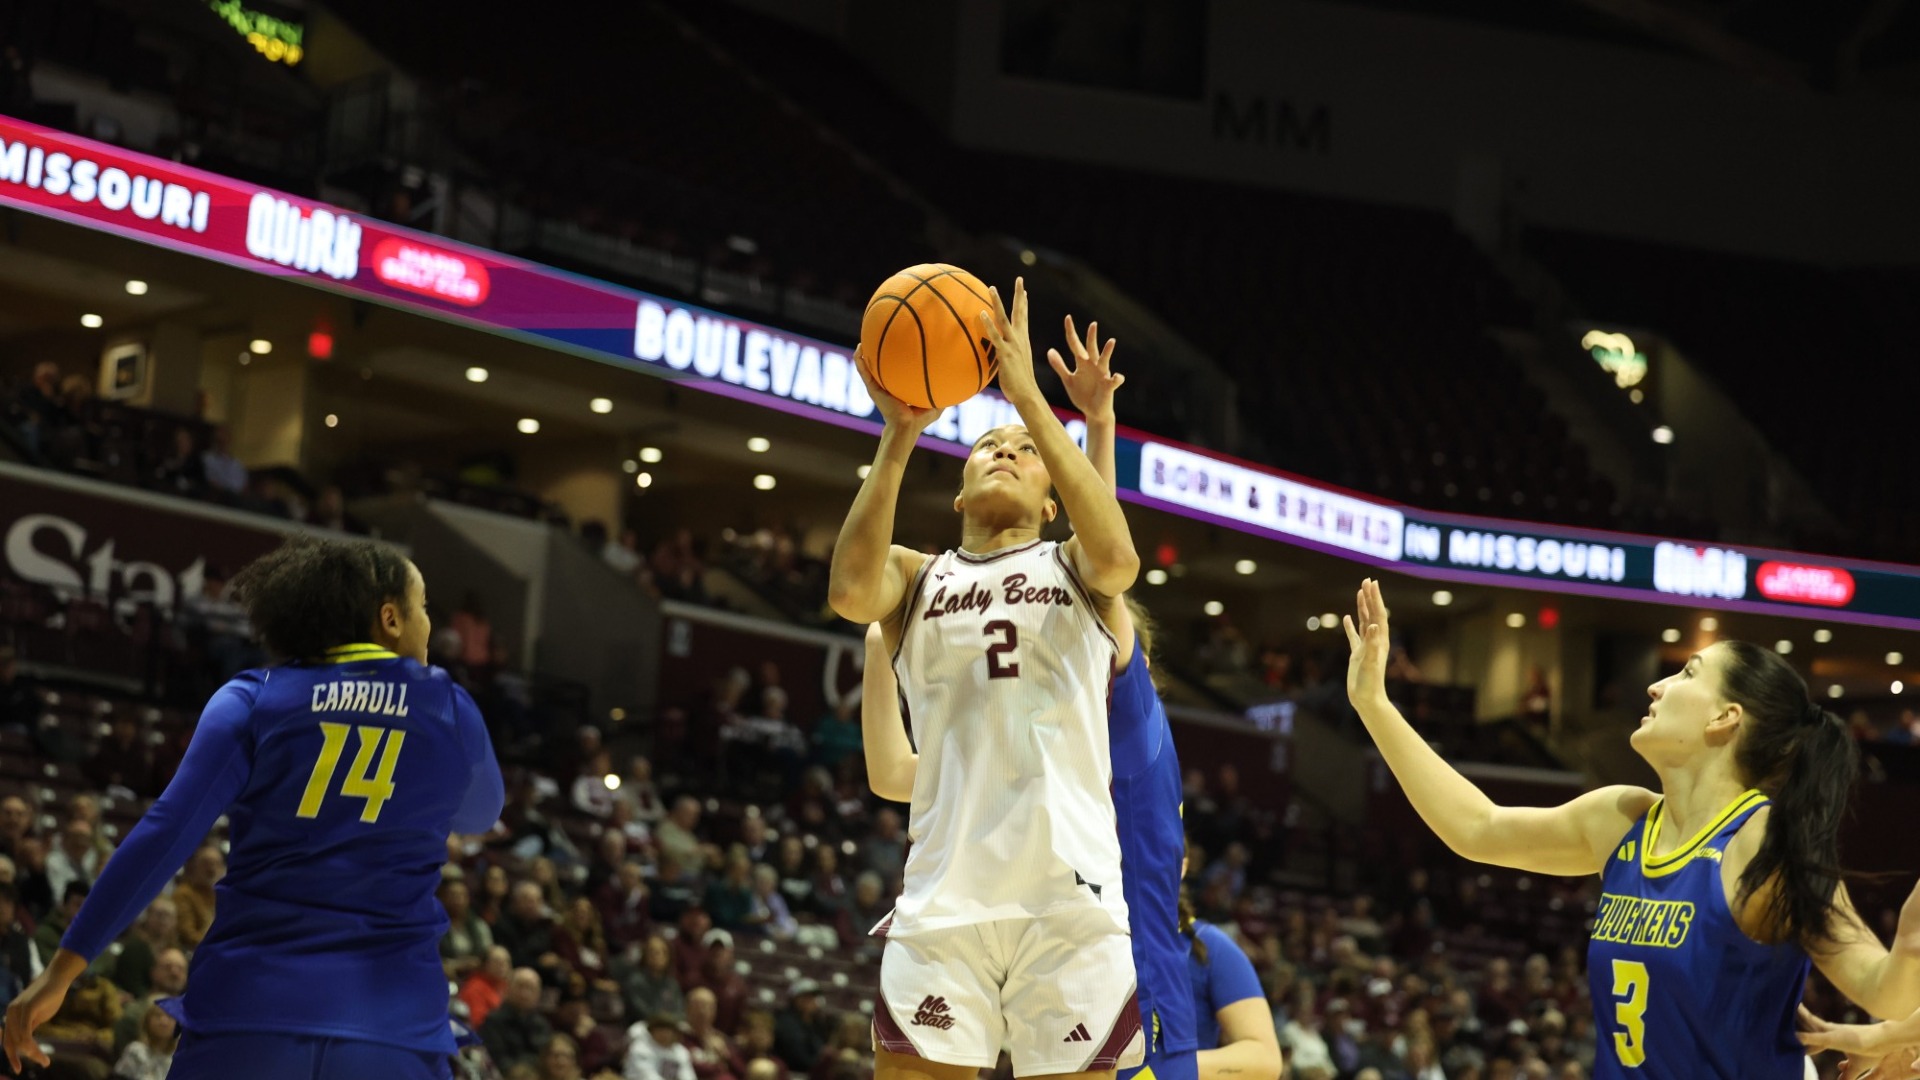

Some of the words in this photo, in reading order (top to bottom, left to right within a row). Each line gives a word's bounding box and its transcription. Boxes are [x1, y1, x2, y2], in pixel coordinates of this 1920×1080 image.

[0, 137, 210, 232] MISSOURI
[5, 513, 235, 628] Stat
[1404, 520, 1441, 561] IN
[1449, 529, 1625, 582] MISSOURI
[923, 581, 993, 621] Lady
[1001, 572, 1074, 608] Bears
[982, 619, 1021, 682] 2
[311, 680, 409, 718] CARROLL
[296, 721, 407, 824] 14
[910, 1010, 956, 1031] State
[918, 994, 952, 1015] Mo
[1611, 958, 1650, 1068] 3
